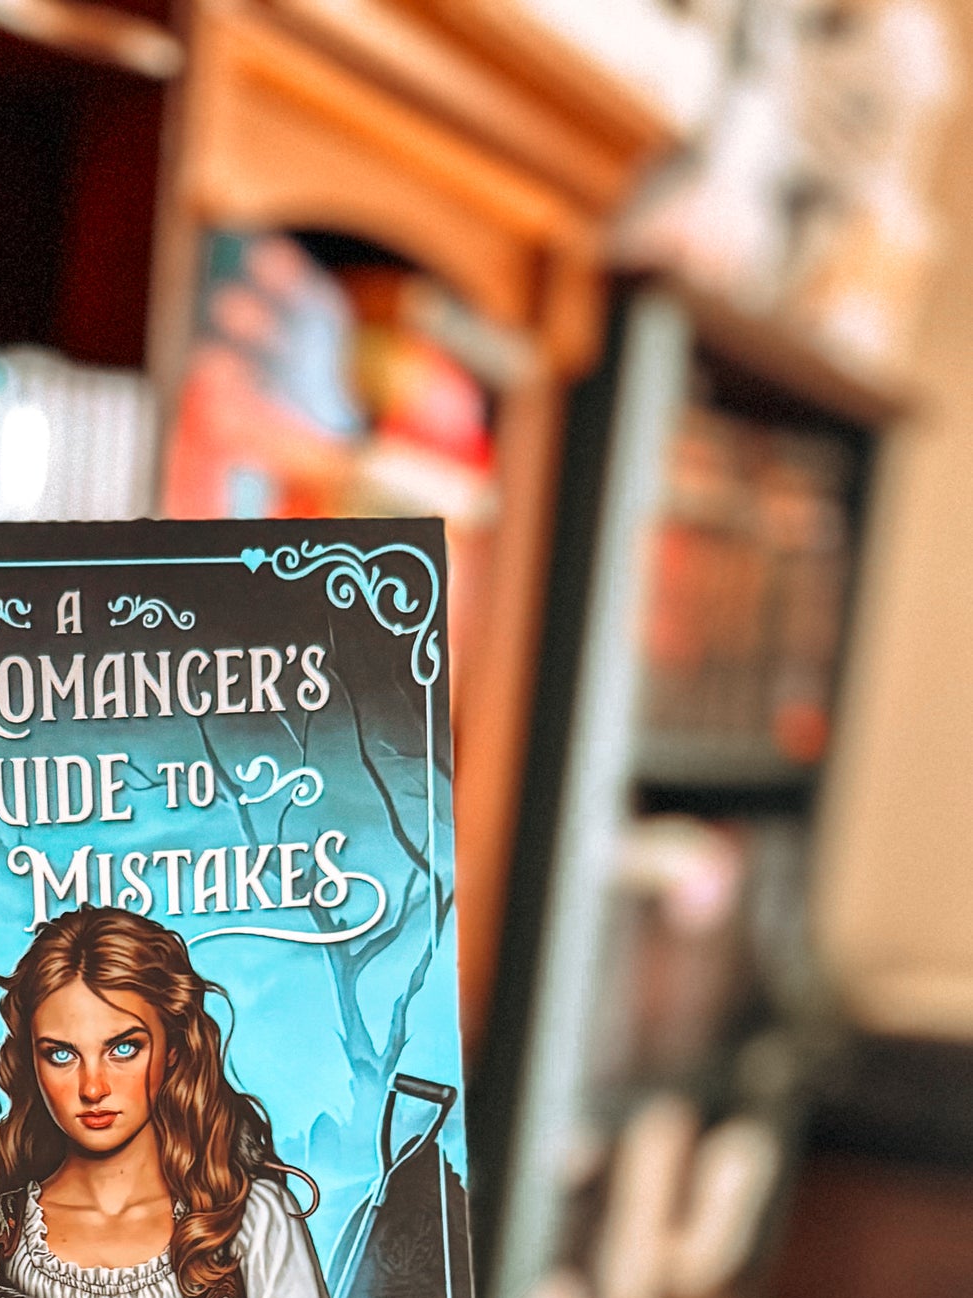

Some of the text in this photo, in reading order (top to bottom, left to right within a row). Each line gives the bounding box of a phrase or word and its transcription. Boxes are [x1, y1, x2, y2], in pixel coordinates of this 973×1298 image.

[55, 590, 84, 635] A
[157, 760, 216, 810] TO
[7, 830, 387, 945] MISTAKES
